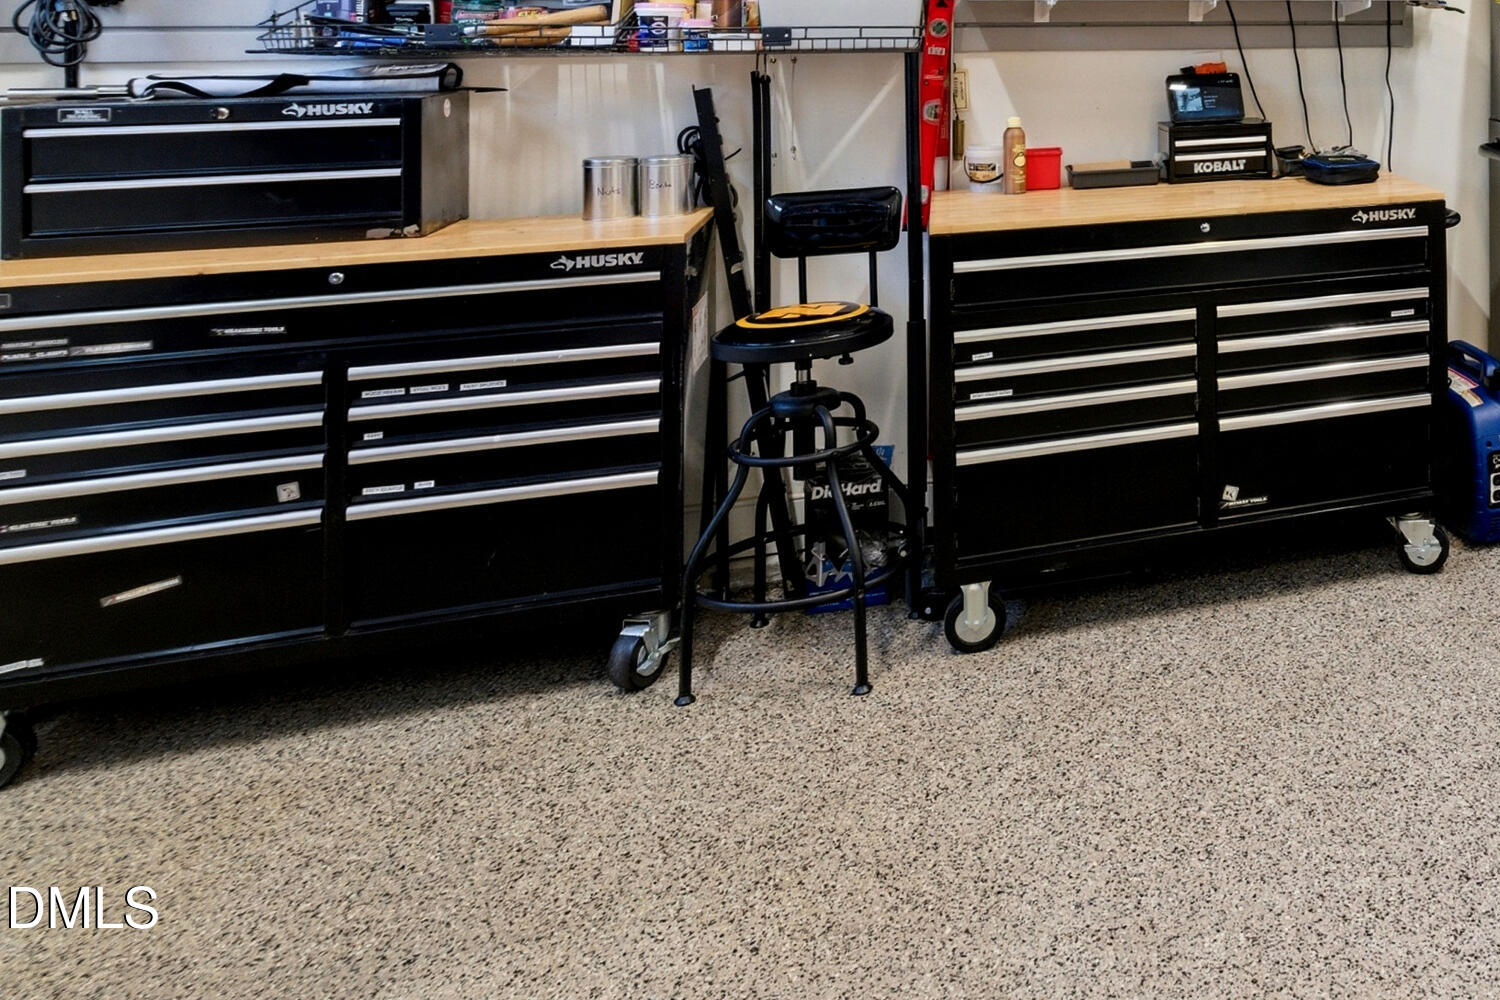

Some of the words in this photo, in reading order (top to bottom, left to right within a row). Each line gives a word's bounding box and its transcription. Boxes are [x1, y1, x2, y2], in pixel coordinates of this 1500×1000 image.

[306, 103, 373, 116] HUSKY
[1194, 160, 1246, 174] KOBALT
[1368, 207, 1416, 222] HUSKY
[576, 252, 644, 269] HUSKY
